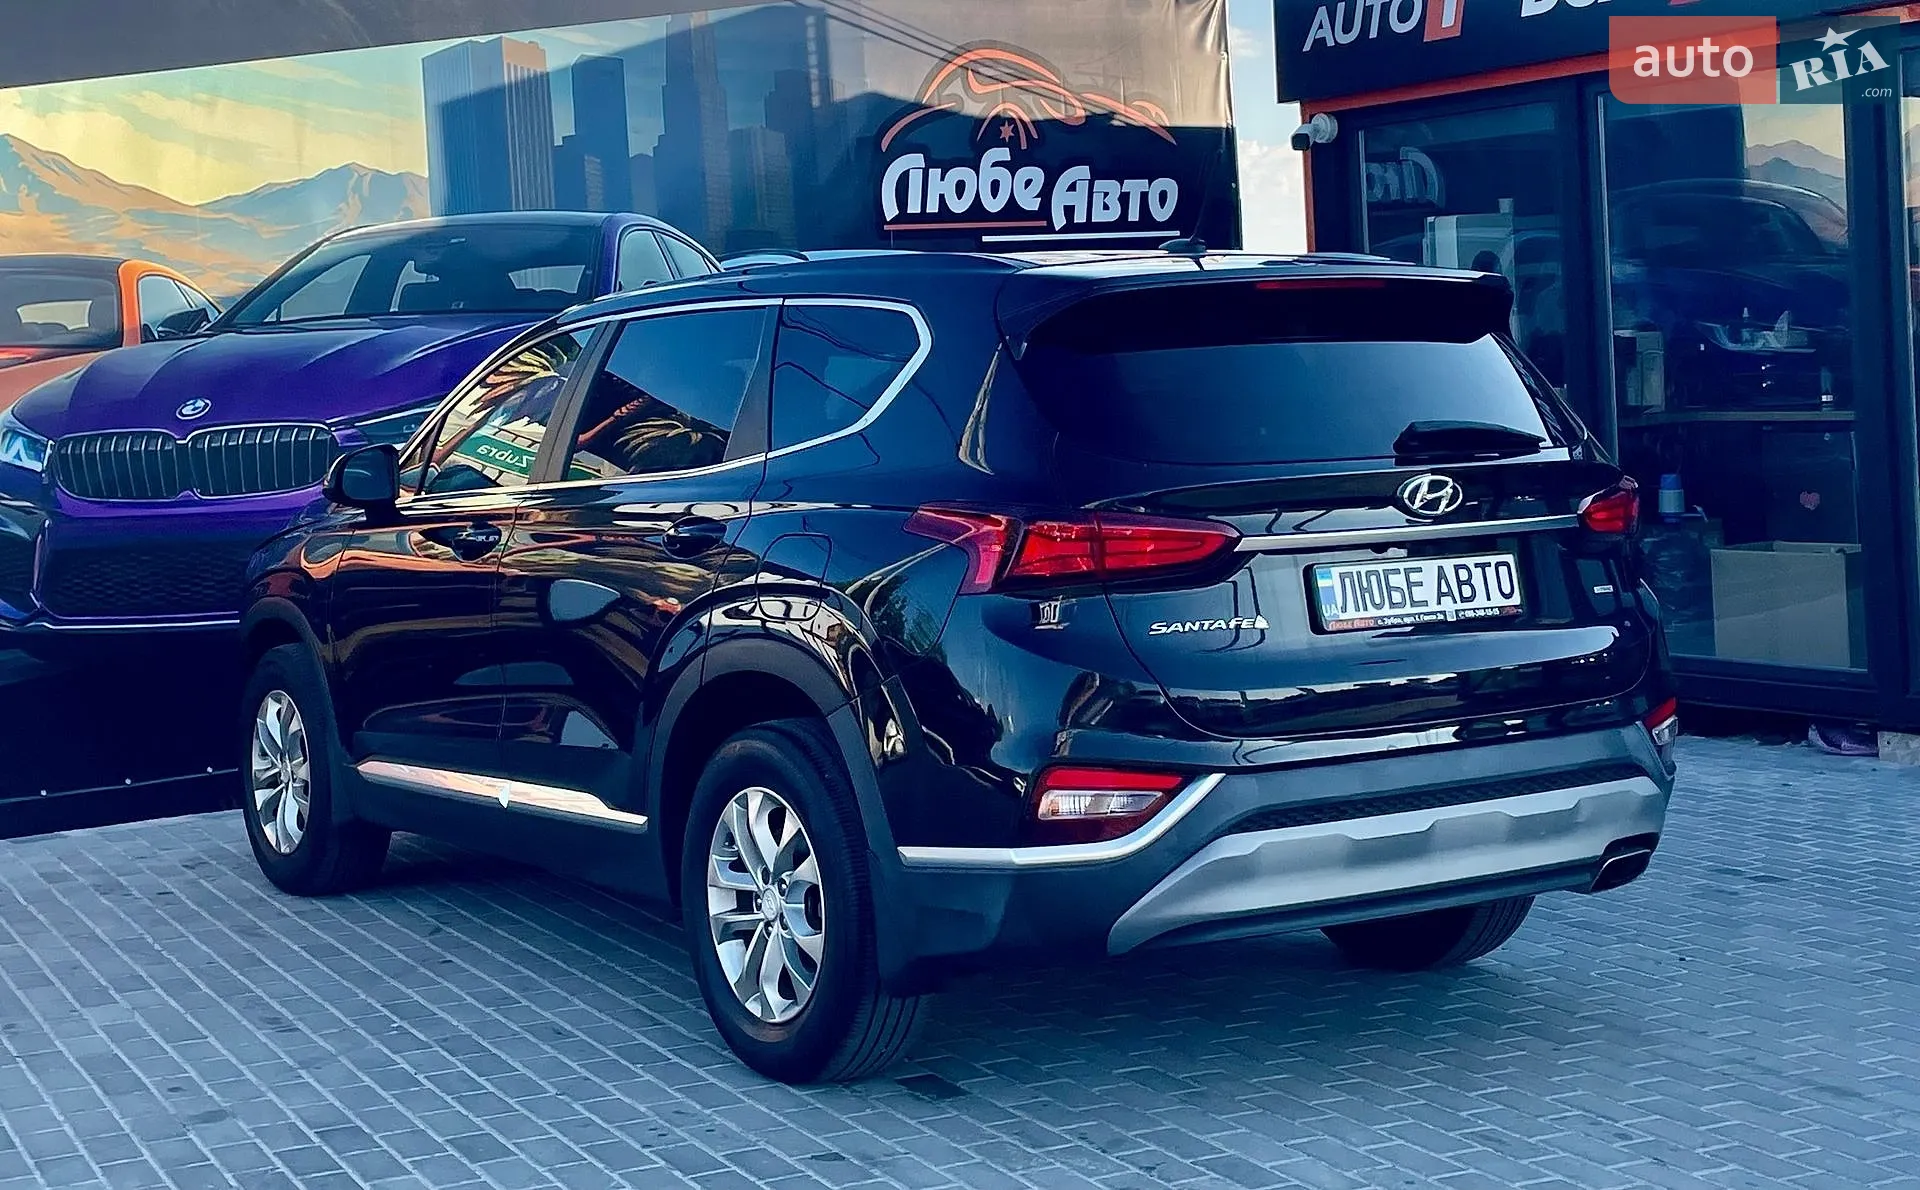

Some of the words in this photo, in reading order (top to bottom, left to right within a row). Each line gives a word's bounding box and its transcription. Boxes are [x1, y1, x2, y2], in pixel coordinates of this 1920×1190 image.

[881, 147, 1045, 222] Любе
[1051, 165, 1179, 231] Авто
[1321, 603, 1340, 617] UA
[1338, 566, 1429, 614] ЛЮБЕ
[1436, 560, 1515, 606] АВТО
